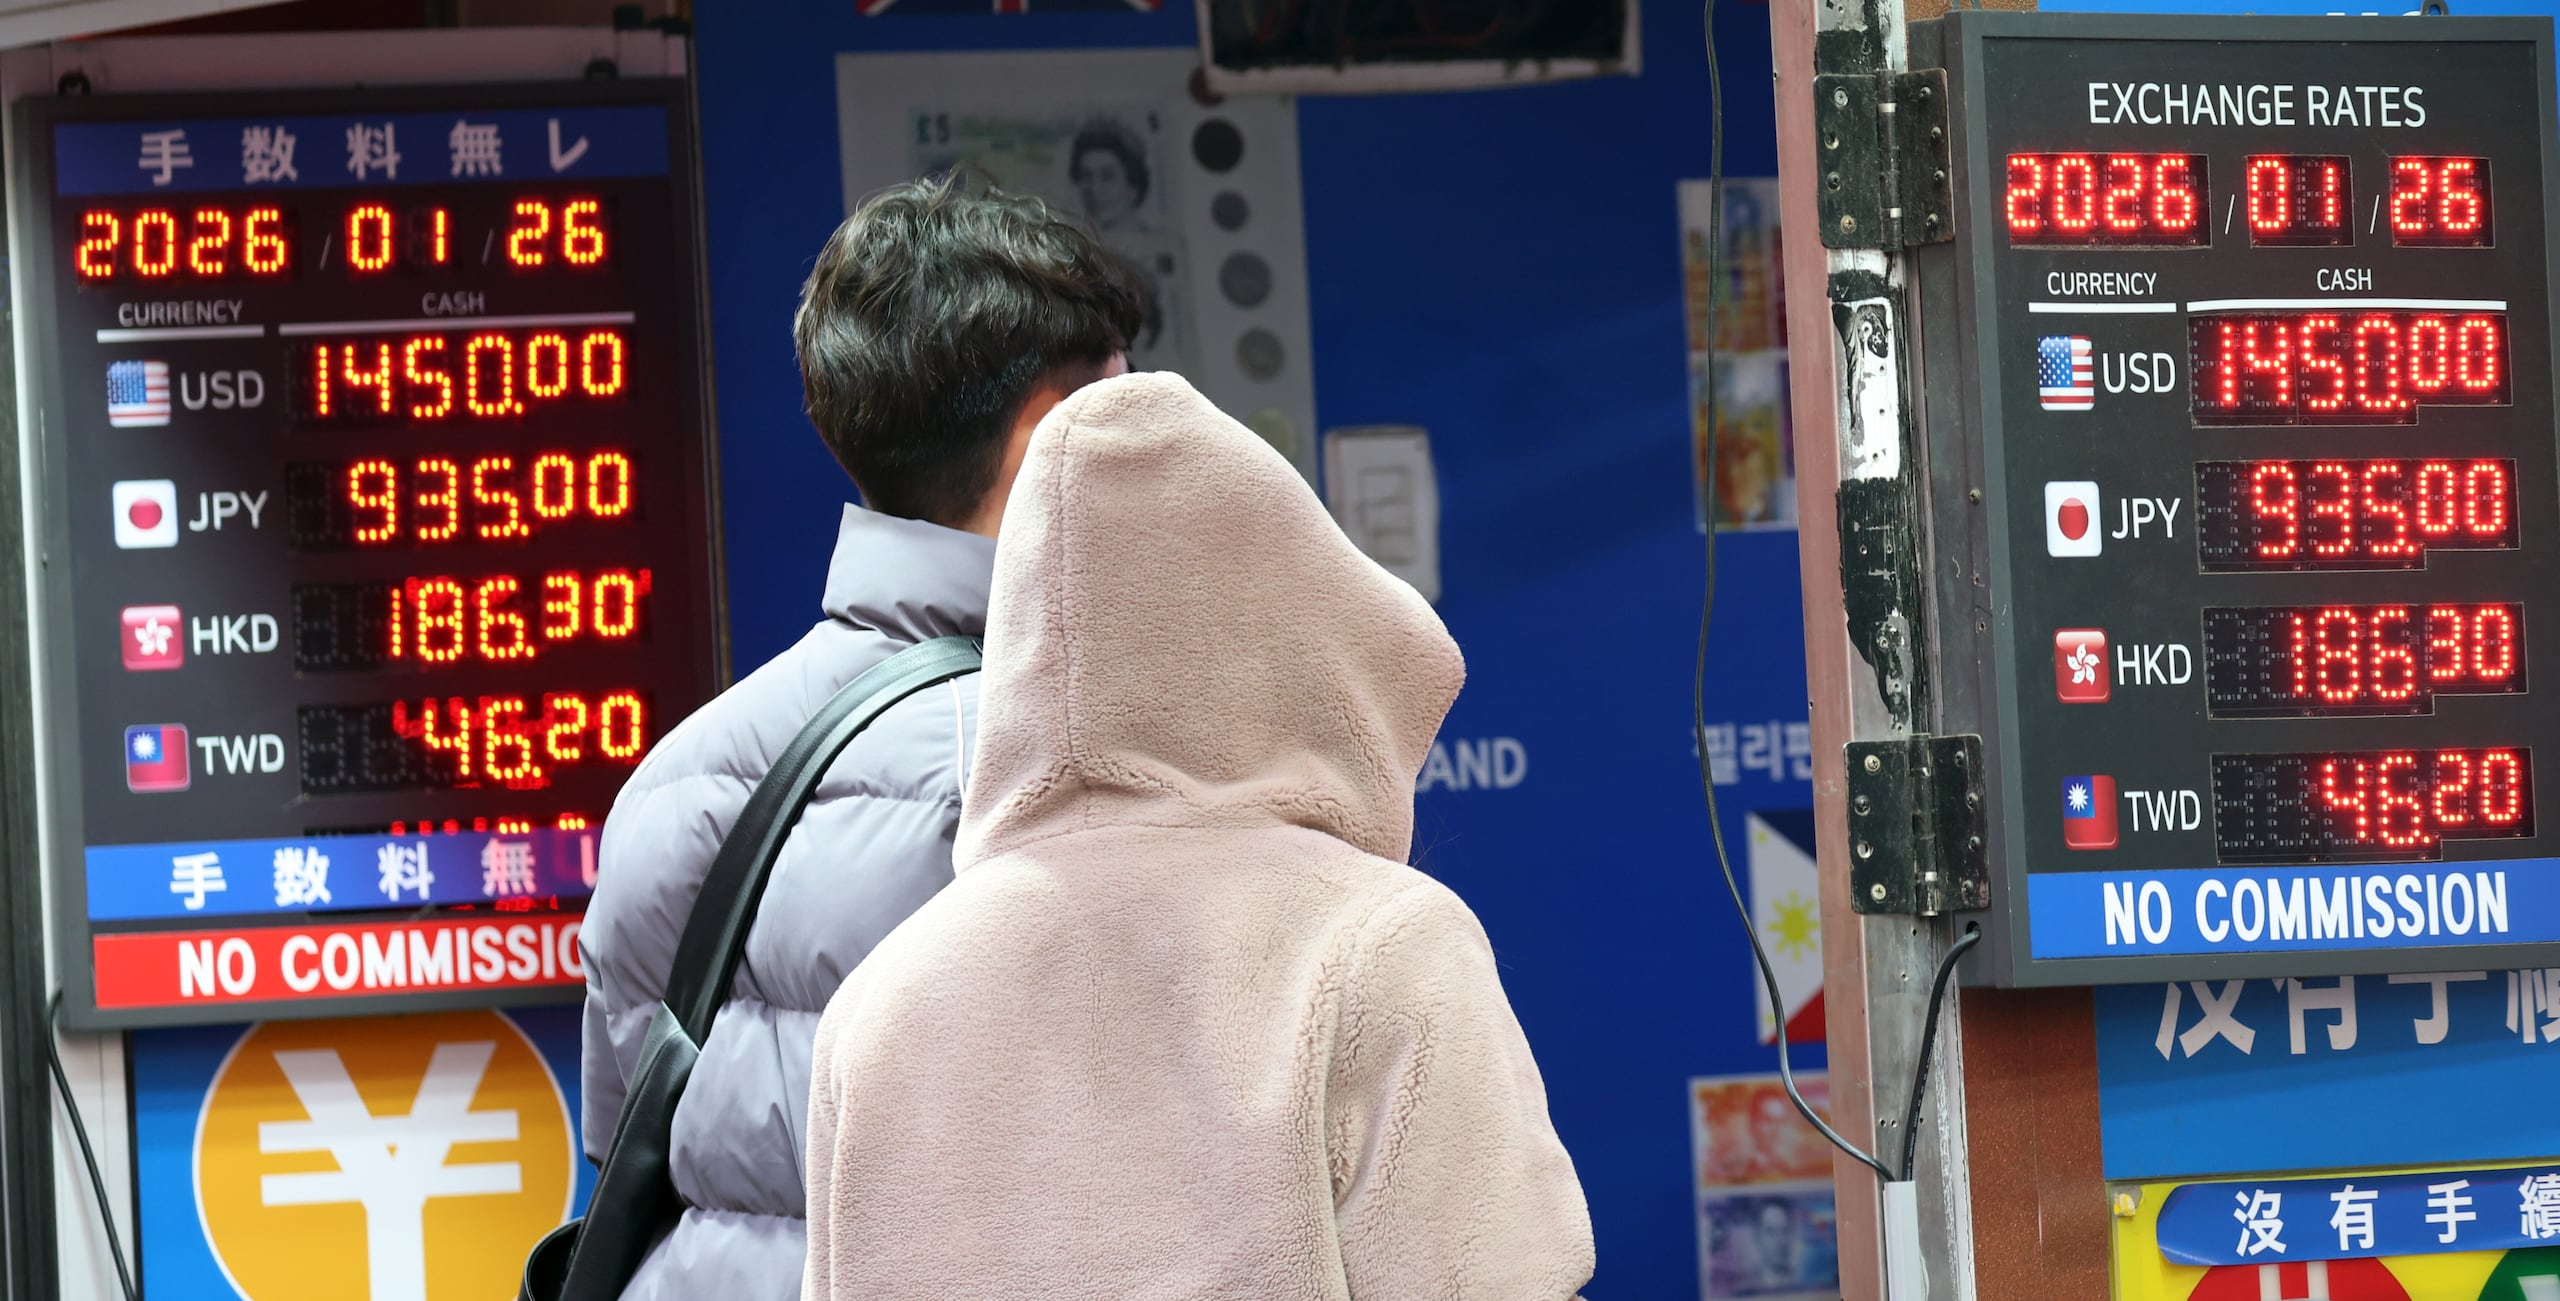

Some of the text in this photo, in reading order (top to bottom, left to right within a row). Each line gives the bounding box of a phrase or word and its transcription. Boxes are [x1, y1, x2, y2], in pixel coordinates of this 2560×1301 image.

[2087, 82, 2427, 128] EXCHANGE RATES
[2006, 156, 2195, 228] 2026
[2250, 160, 2336, 229] 01
[2391, 162, 2478, 231] 26
[78, 209, 286, 278] 2026
[349, 205, 446, 270] 01
[509, 201, 605, 266] 26
[2046, 271, 2158, 297] CURRENCY
[2316, 268, 2373, 292] CASH
[117, 301, 243, 328] CURRENCY
[422, 291, 486, 316] CASH
[179, 370, 265, 410] USD
[2101, 352, 2177, 394] USD
[188, 491, 268, 533] JPY
[2111, 497, 2182, 540] JPY
[191, 613, 280, 656] HKD
[390, 573, 636, 663] 186.30
[2115, 642, 2194, 687] HKD
[196, 733, 286, 776] TWD
[1416, 736, 1529, 793] AND
[2123, 789, 2202, 833] TWD
[2103, 871, 2510, 946] NO COMMISSION
[178, 921, 585, 998] NO COMMISSIO
